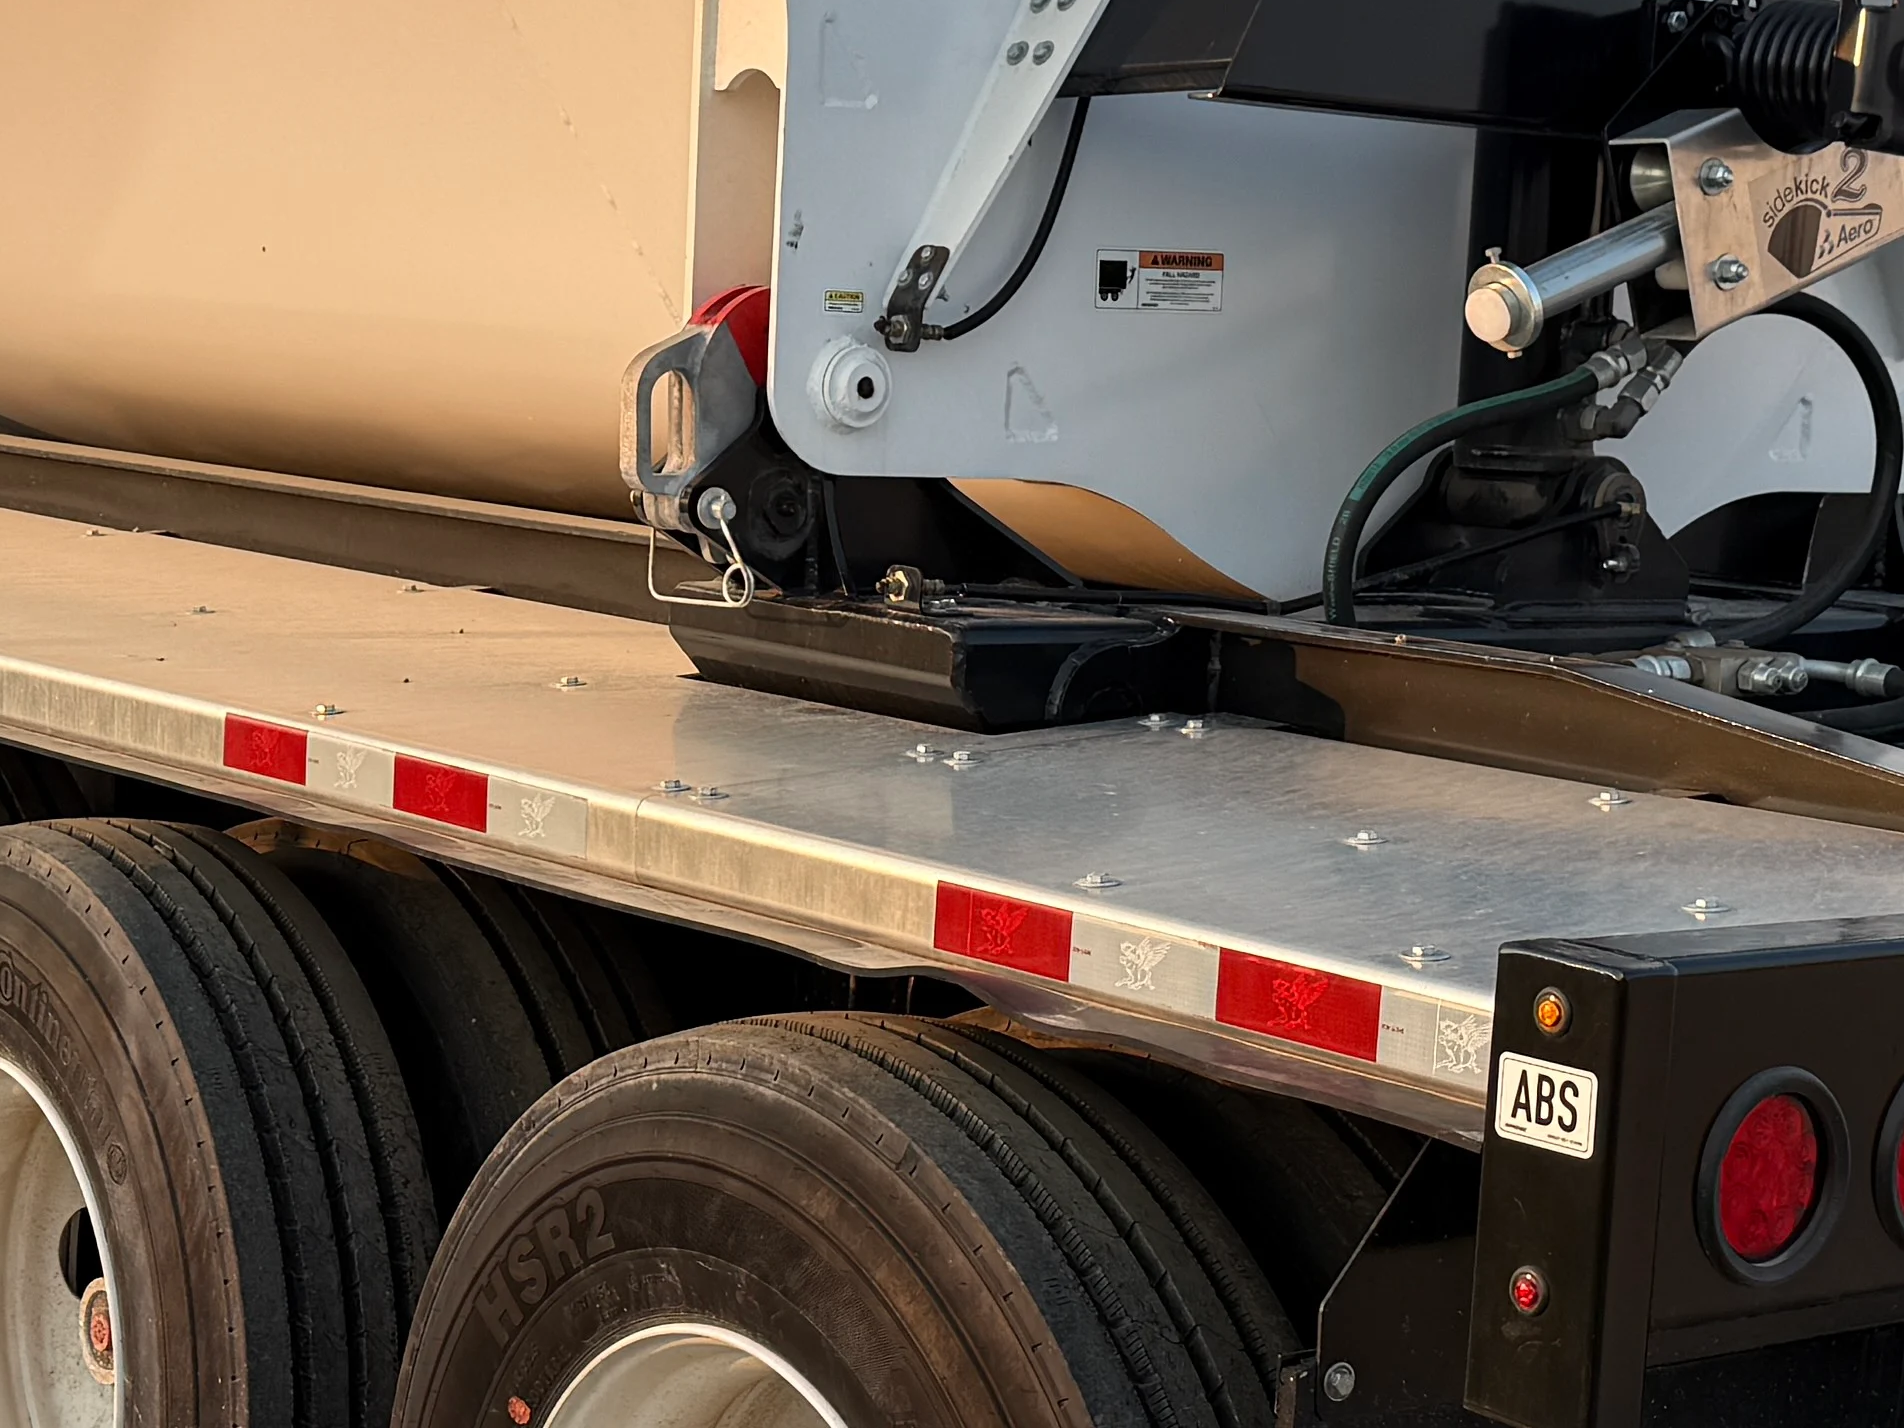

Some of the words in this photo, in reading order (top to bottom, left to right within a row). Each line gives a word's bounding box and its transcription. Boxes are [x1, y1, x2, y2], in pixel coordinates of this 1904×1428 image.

[1763, 173, 1831, 228] sidekick
[1831, 147, 1869, 202] 2
[1160, 254, 1213, 267] WARNING
[1837, 218, 1873, 248] Aero
[1511, 1069, 1579, 1133] ABS
[473, 1187, 615, 1349] HSR2
